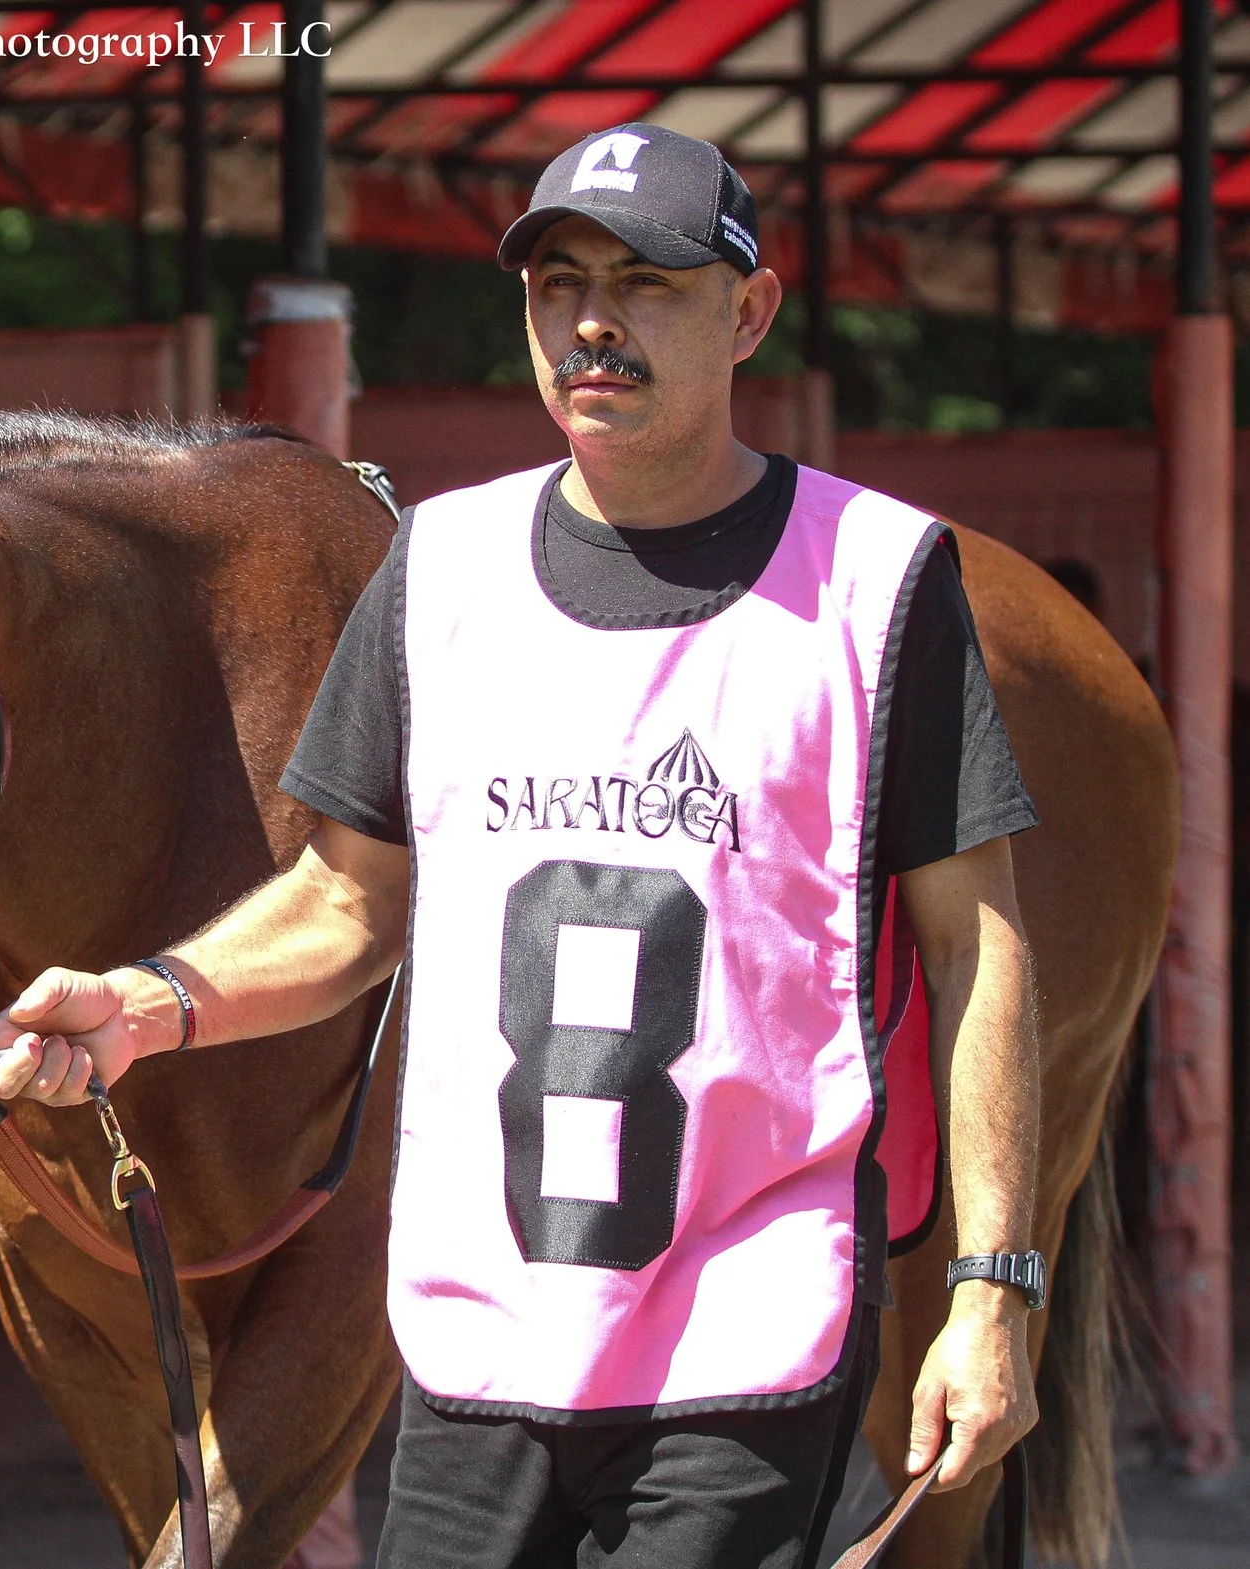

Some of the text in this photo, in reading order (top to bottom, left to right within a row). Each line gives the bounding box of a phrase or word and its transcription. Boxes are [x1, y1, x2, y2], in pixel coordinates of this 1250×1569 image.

[486, 775, 742, 854] SARATOGA
[156, 965, 192, 1010] STRONG!
[498, 859, 708, 1272] 8
